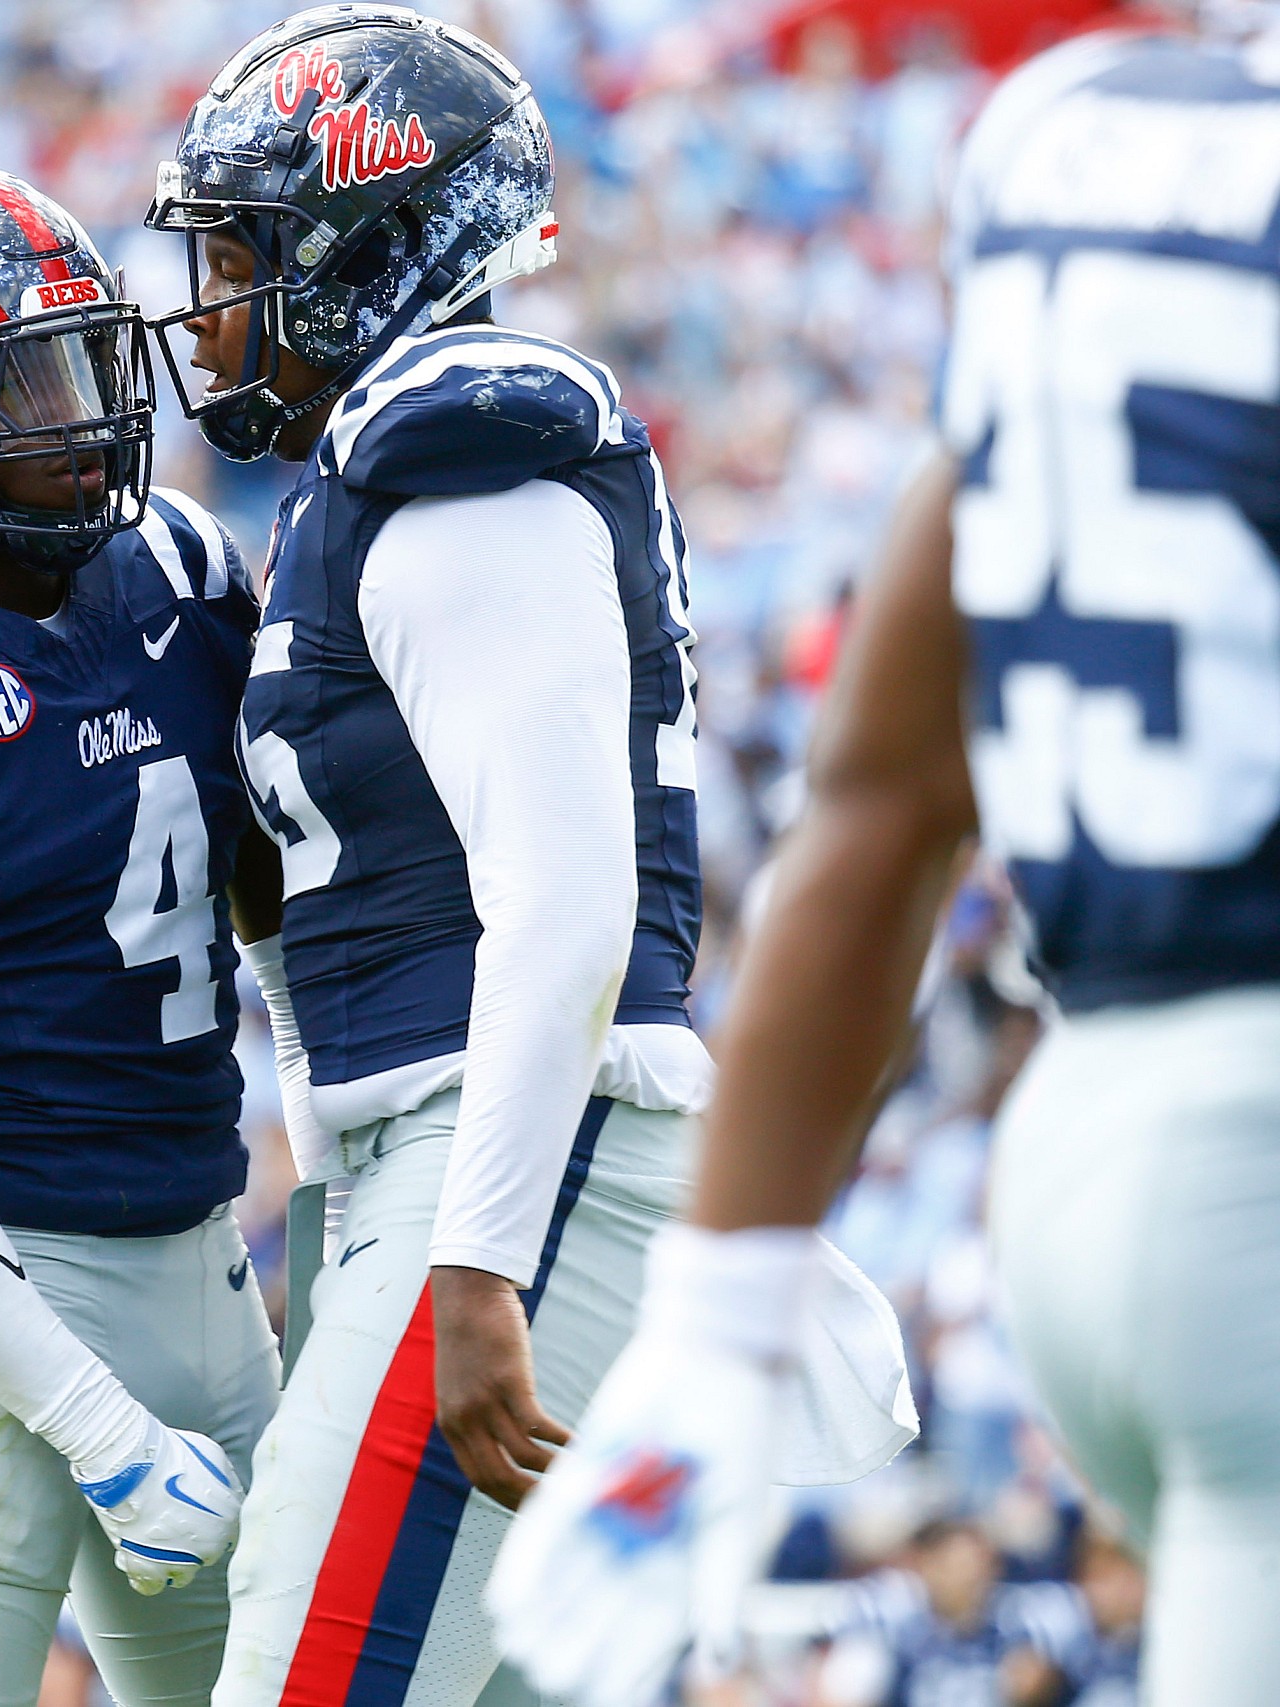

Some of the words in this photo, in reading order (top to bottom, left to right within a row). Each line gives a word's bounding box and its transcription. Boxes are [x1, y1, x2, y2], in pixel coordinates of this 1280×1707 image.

[272, 40, 346, 118] Ole
[308, 101, 437, 192] Miss
[36, 278, 100, 310] REBS
[78, 715, 113, 769] Ole
[105, 706, 163, 758] Miss
[104, 754, 220, 1045] 4
